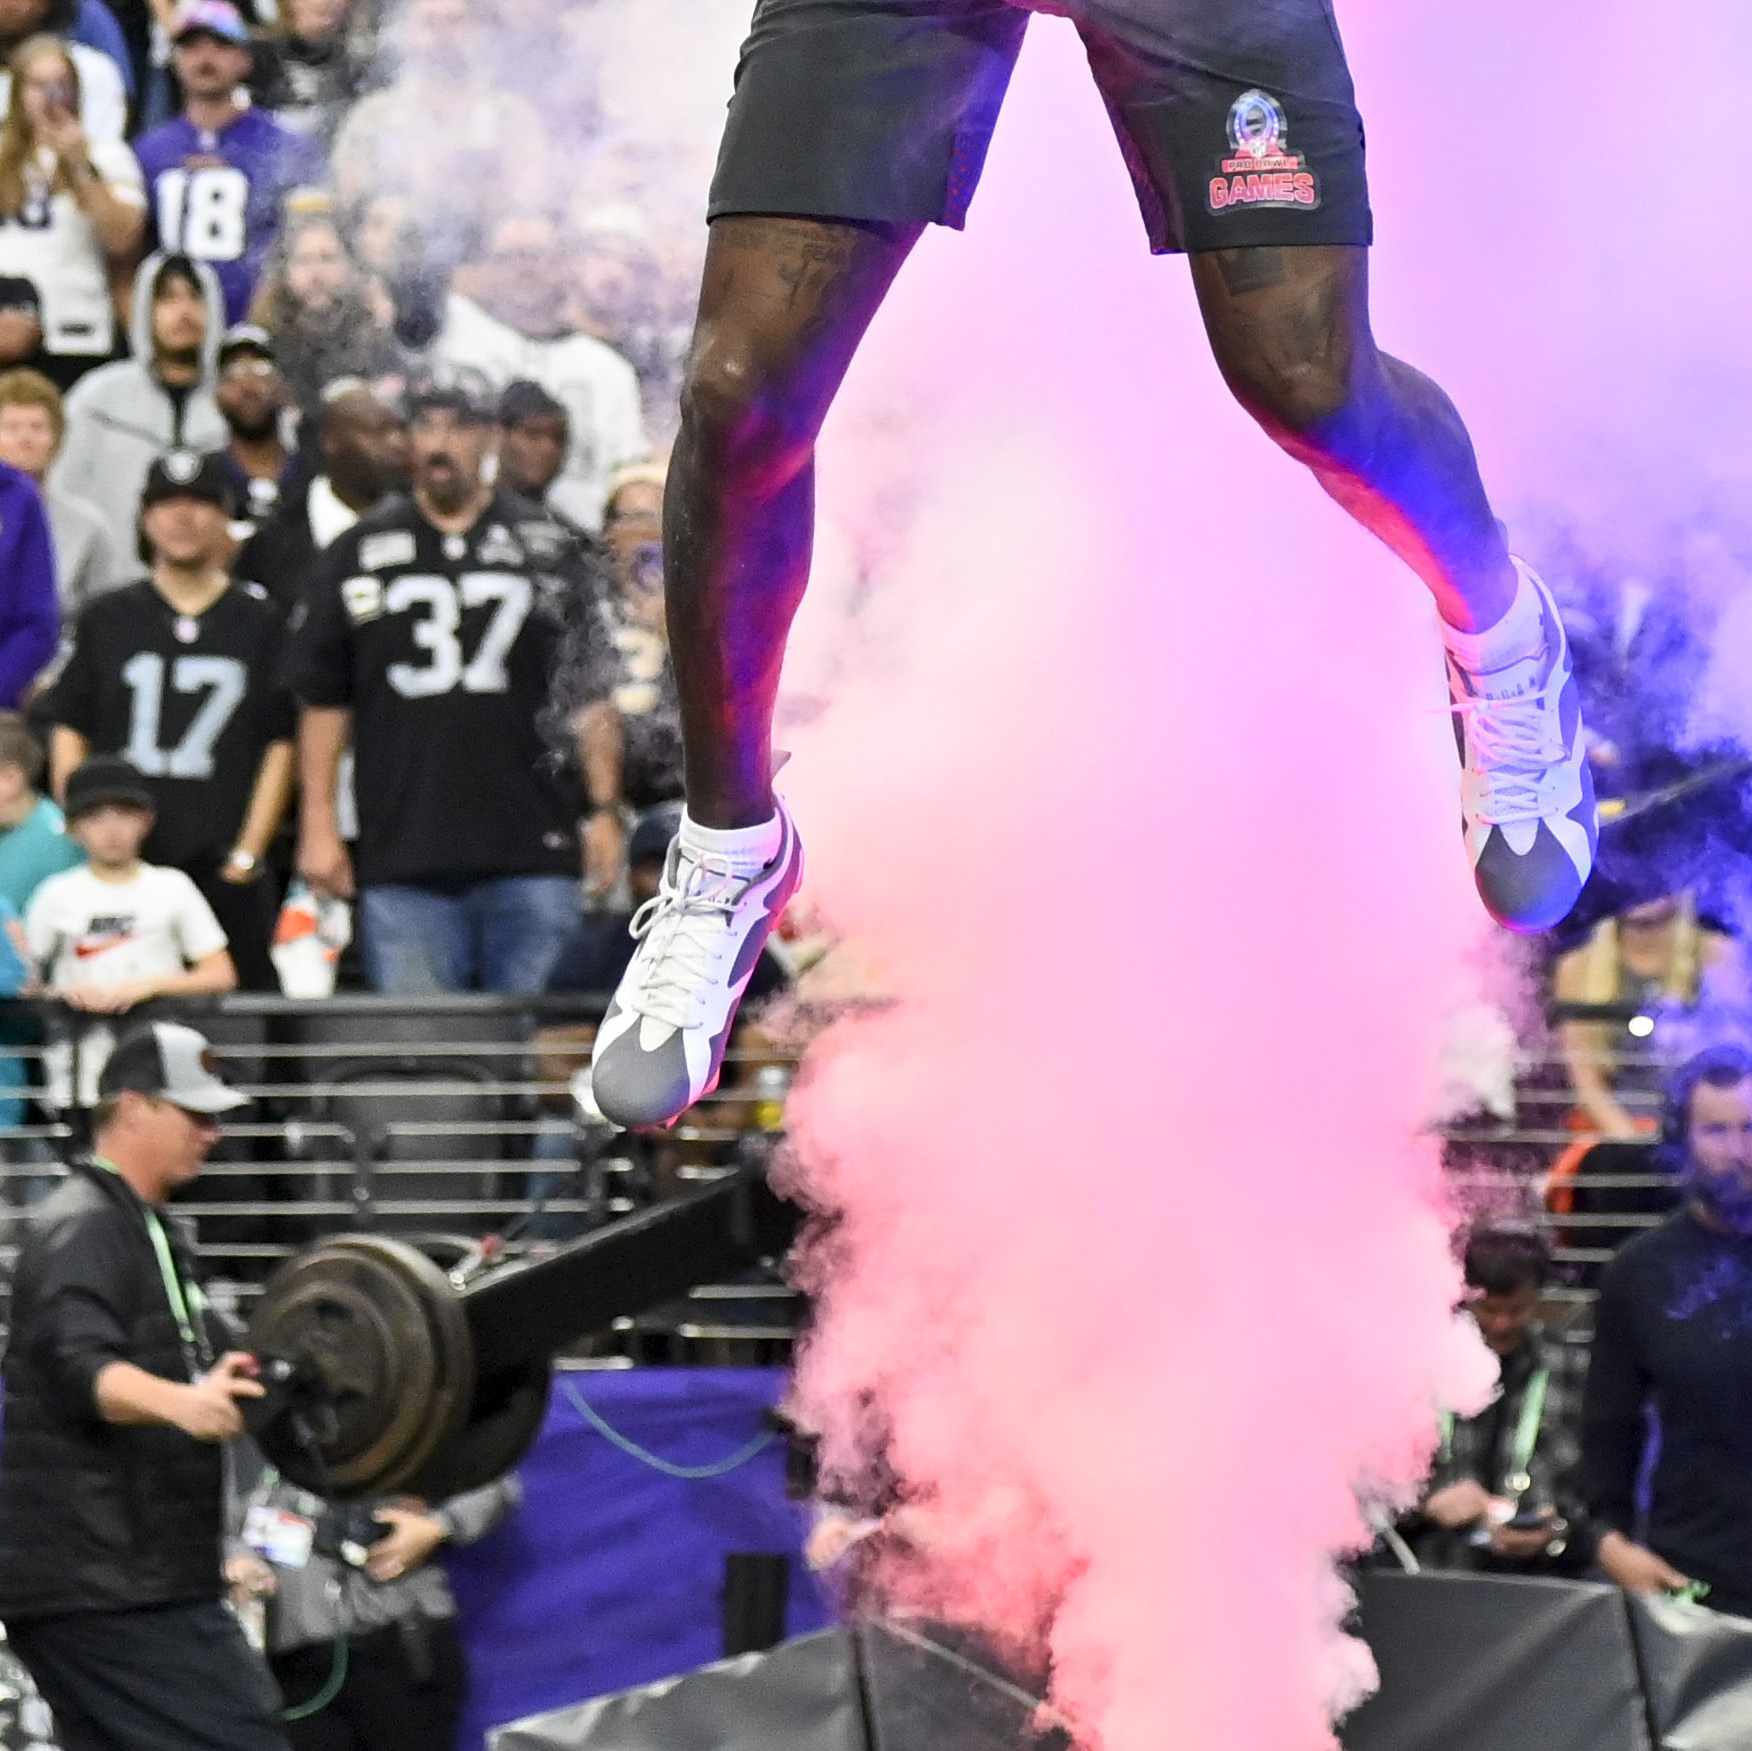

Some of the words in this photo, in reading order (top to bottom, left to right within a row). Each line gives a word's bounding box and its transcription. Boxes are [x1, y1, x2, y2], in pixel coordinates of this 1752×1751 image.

[1209, 173, 1316, 209] GAMES
[1229, 159, 1252, 169] PRO
[153, 165, 249, 262] 18
[387, 572, 533, 698] 37
[121, 651, 248, 780] 17
